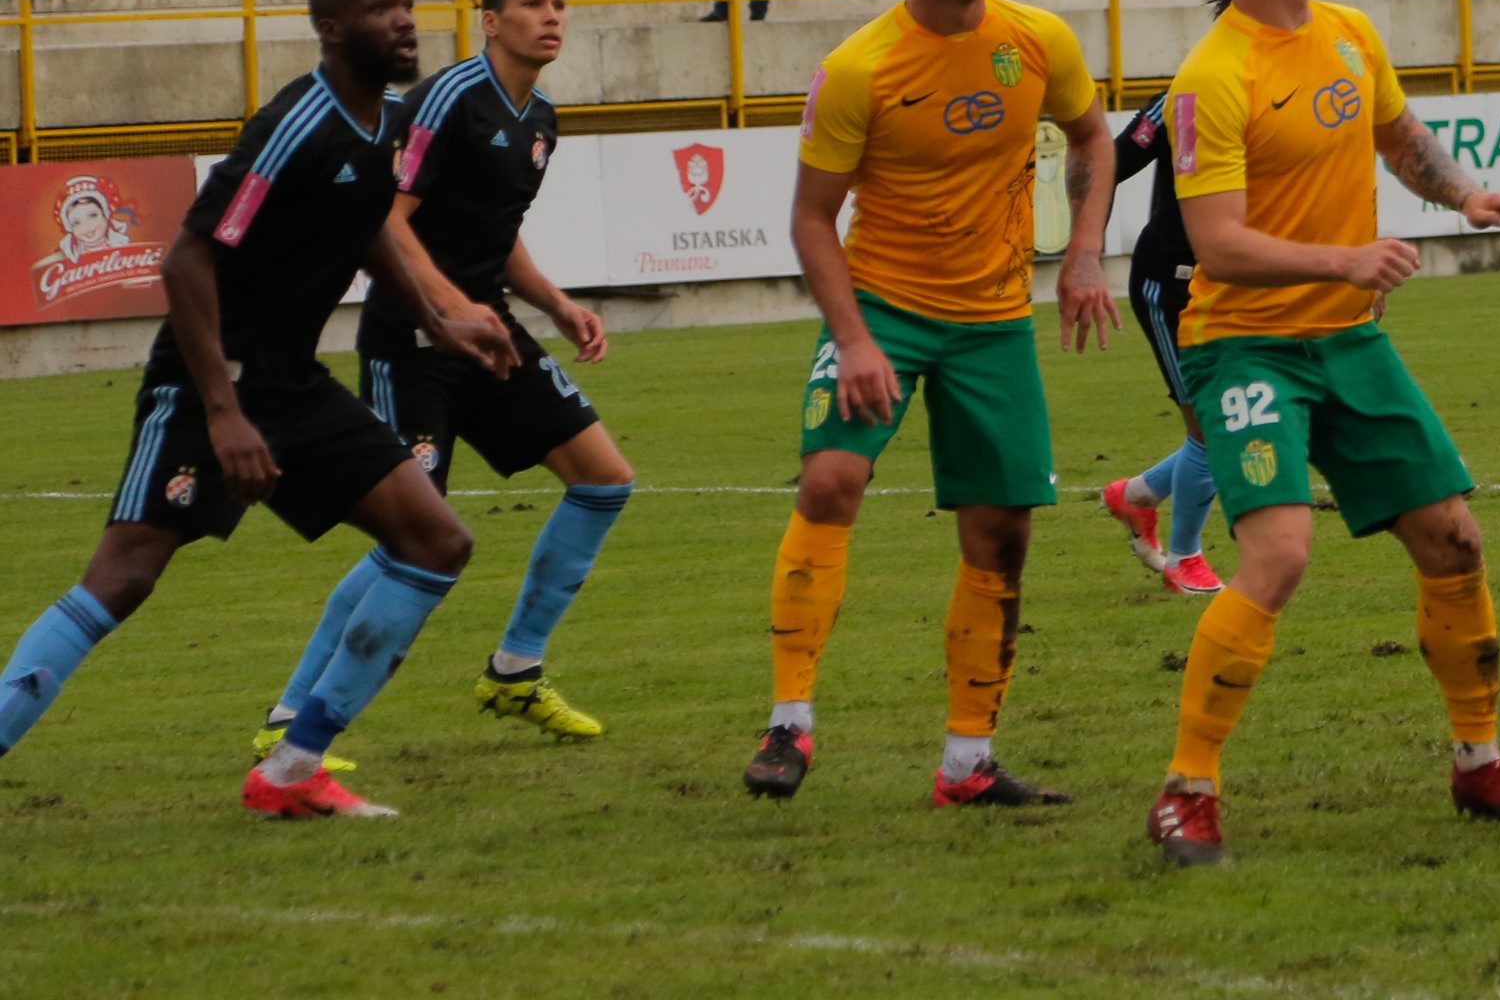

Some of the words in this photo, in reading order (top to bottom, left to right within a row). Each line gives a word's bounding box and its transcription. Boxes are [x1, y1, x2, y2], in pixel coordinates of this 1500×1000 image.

[672, 228, 767, 251] ISTARSKA
[40, 247, 162, 300] Gavrilović
[1220, 382, 1279, 432] 92
